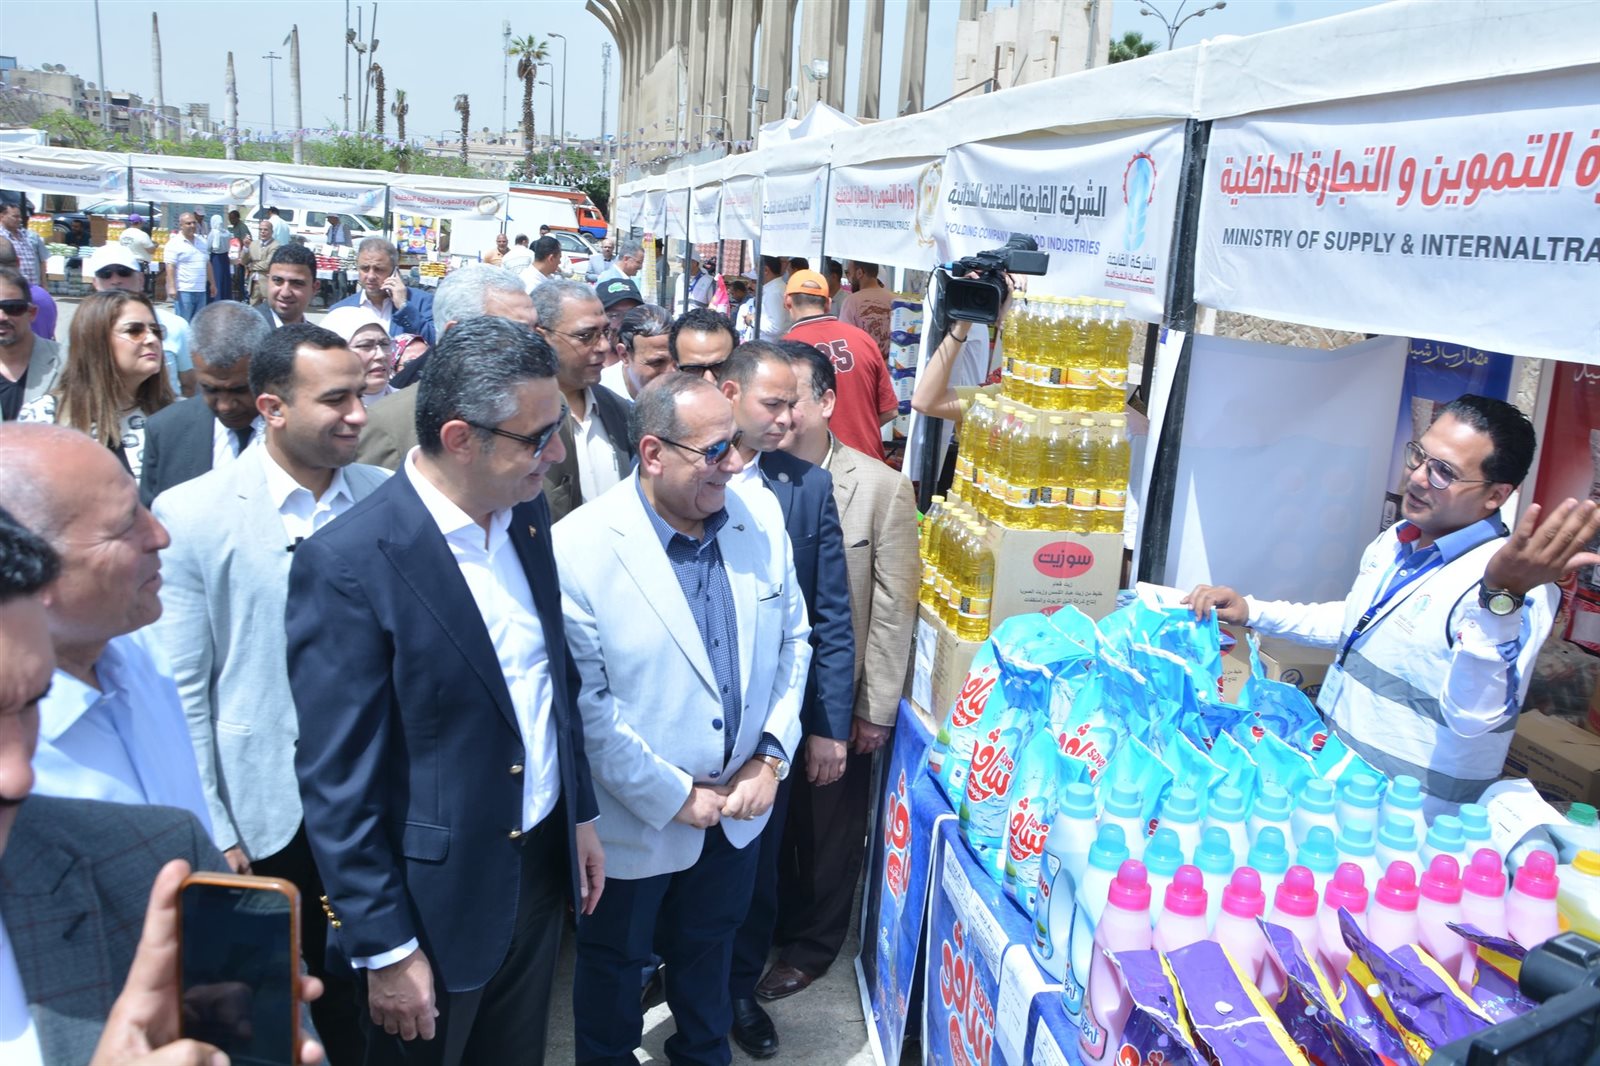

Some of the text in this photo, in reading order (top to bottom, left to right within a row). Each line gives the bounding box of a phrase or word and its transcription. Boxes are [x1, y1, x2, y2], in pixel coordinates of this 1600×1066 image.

[1219, 152, 1304, 206] الداخلية
[1305, 145, 1396, 206] التجارة
[1421, 132, 1574, 206] التموين
[981, 183, 1018, 211] للصناعات
[1019, 184, 1058, 220] القابضة
[1060, 179, 1108, 224] الشركة
[945, 222, 978, 237] HOLDING
[978, 227, 1010, 243] COMPANY
[1047, 237, 1101, 256] INDUSTRIES
[1222, 227, 1294, 248] MINISTRY
[1296, 230, 1320, 249] OF
[1323, 231, 1395, 253] SUPPLY
[1400, 234, 1414, 254] &
[1038, 550, 1091, 568] سوزيت
